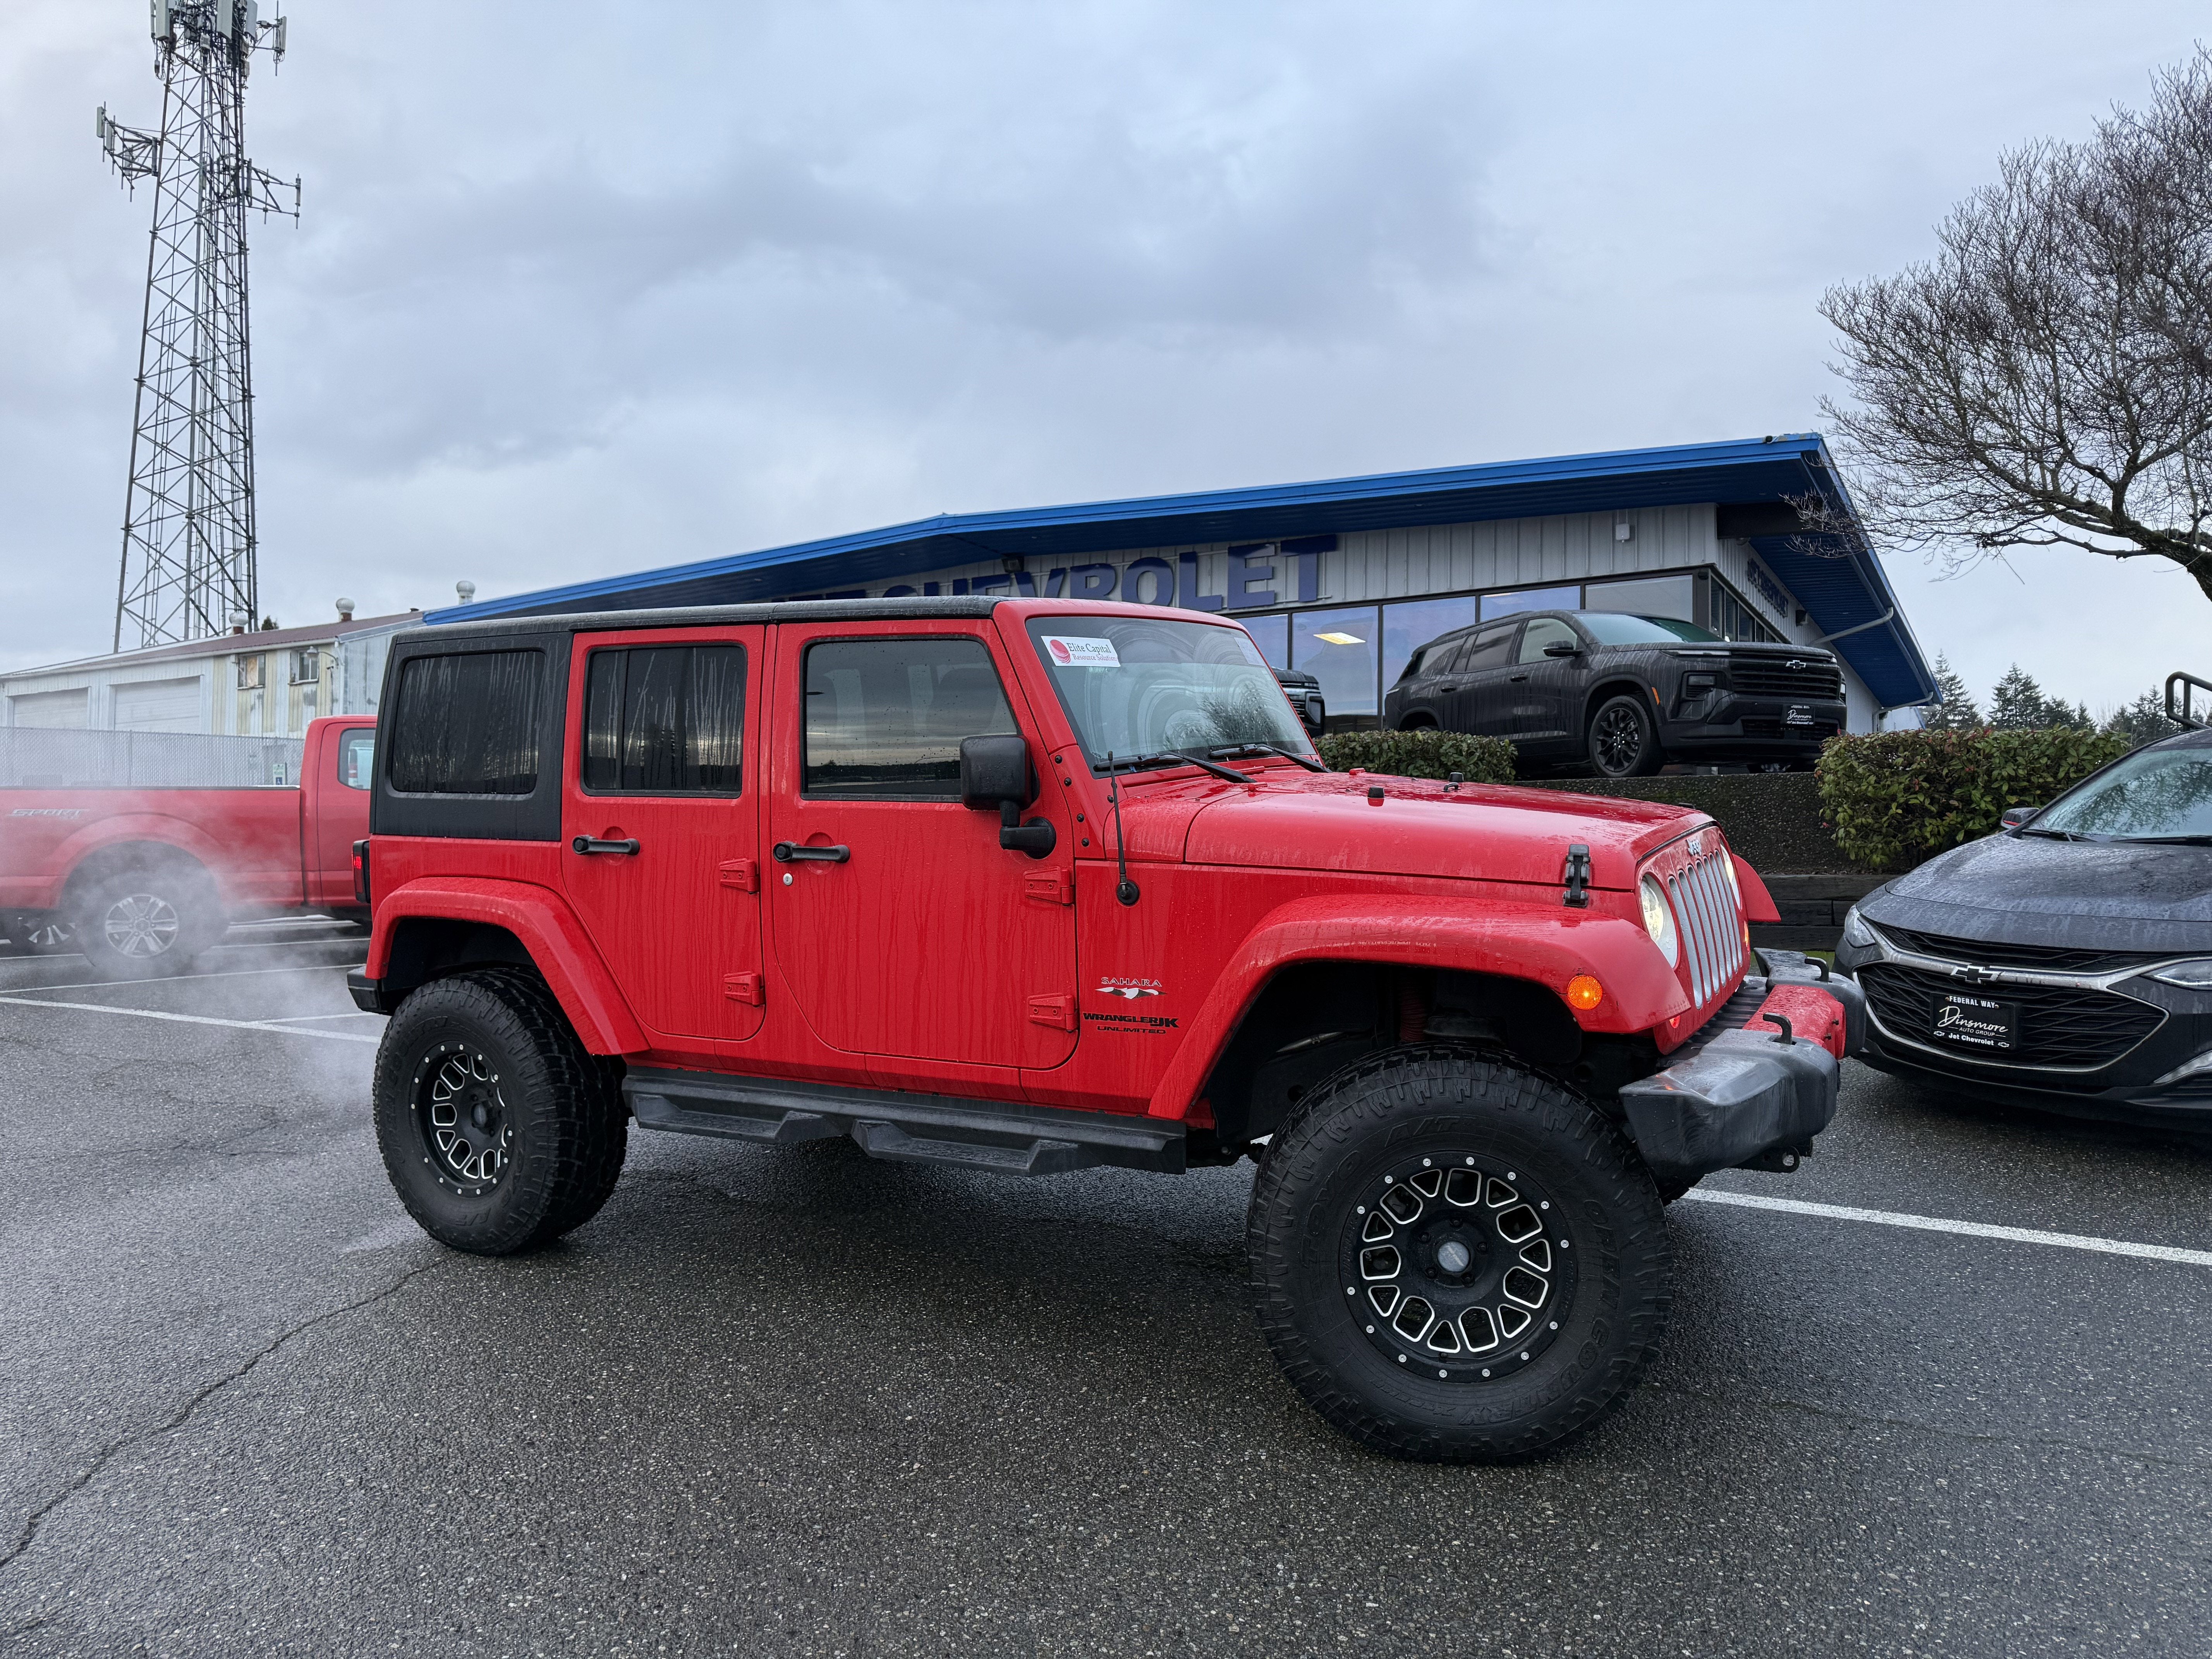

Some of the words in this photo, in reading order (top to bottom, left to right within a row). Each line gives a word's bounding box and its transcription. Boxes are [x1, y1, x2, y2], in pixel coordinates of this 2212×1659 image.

[1066, 643, 1085, 652] Elite
[1085, 643, 1111, 655] Capital
[1101, 977, 1162, 987] SAHARA
[1949, 996, 1978, 1006] FEDERAL
[1981, 1000, 1995, 1008] WAY
[1083, 1012, 1158, 1024] WRANGLER
[1937, 1005, 2008, 1032] Dinsmore
[1097, 1025, 1166, 1034] UNLIMITED
[1961, 1035, 1994, 1046] Chevrolet
